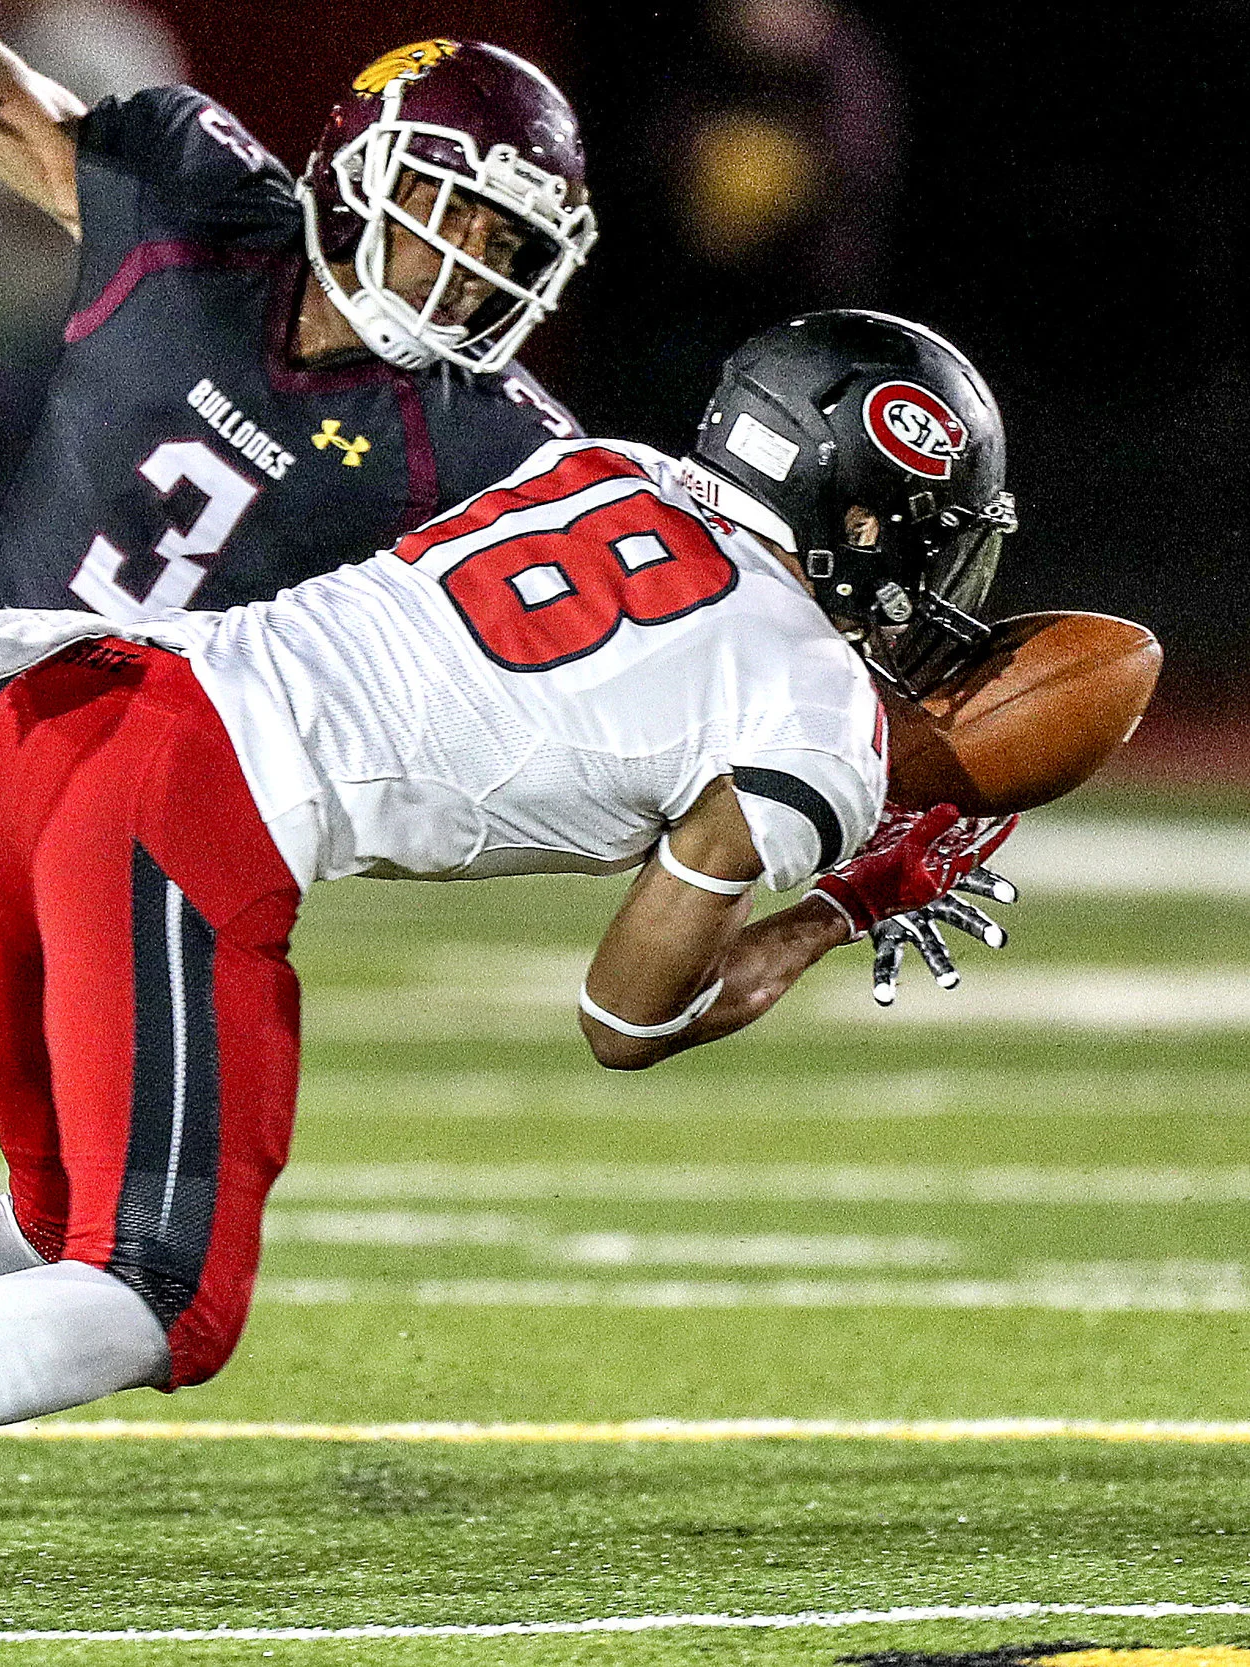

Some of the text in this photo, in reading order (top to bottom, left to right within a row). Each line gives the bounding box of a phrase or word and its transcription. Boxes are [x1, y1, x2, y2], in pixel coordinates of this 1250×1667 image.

[187, 378, 297, 480] BULLDOGS
[503, 377, 573, 438] 3
[66, 437, 267, 620] 3
[394, 446, 740, 673] 18
